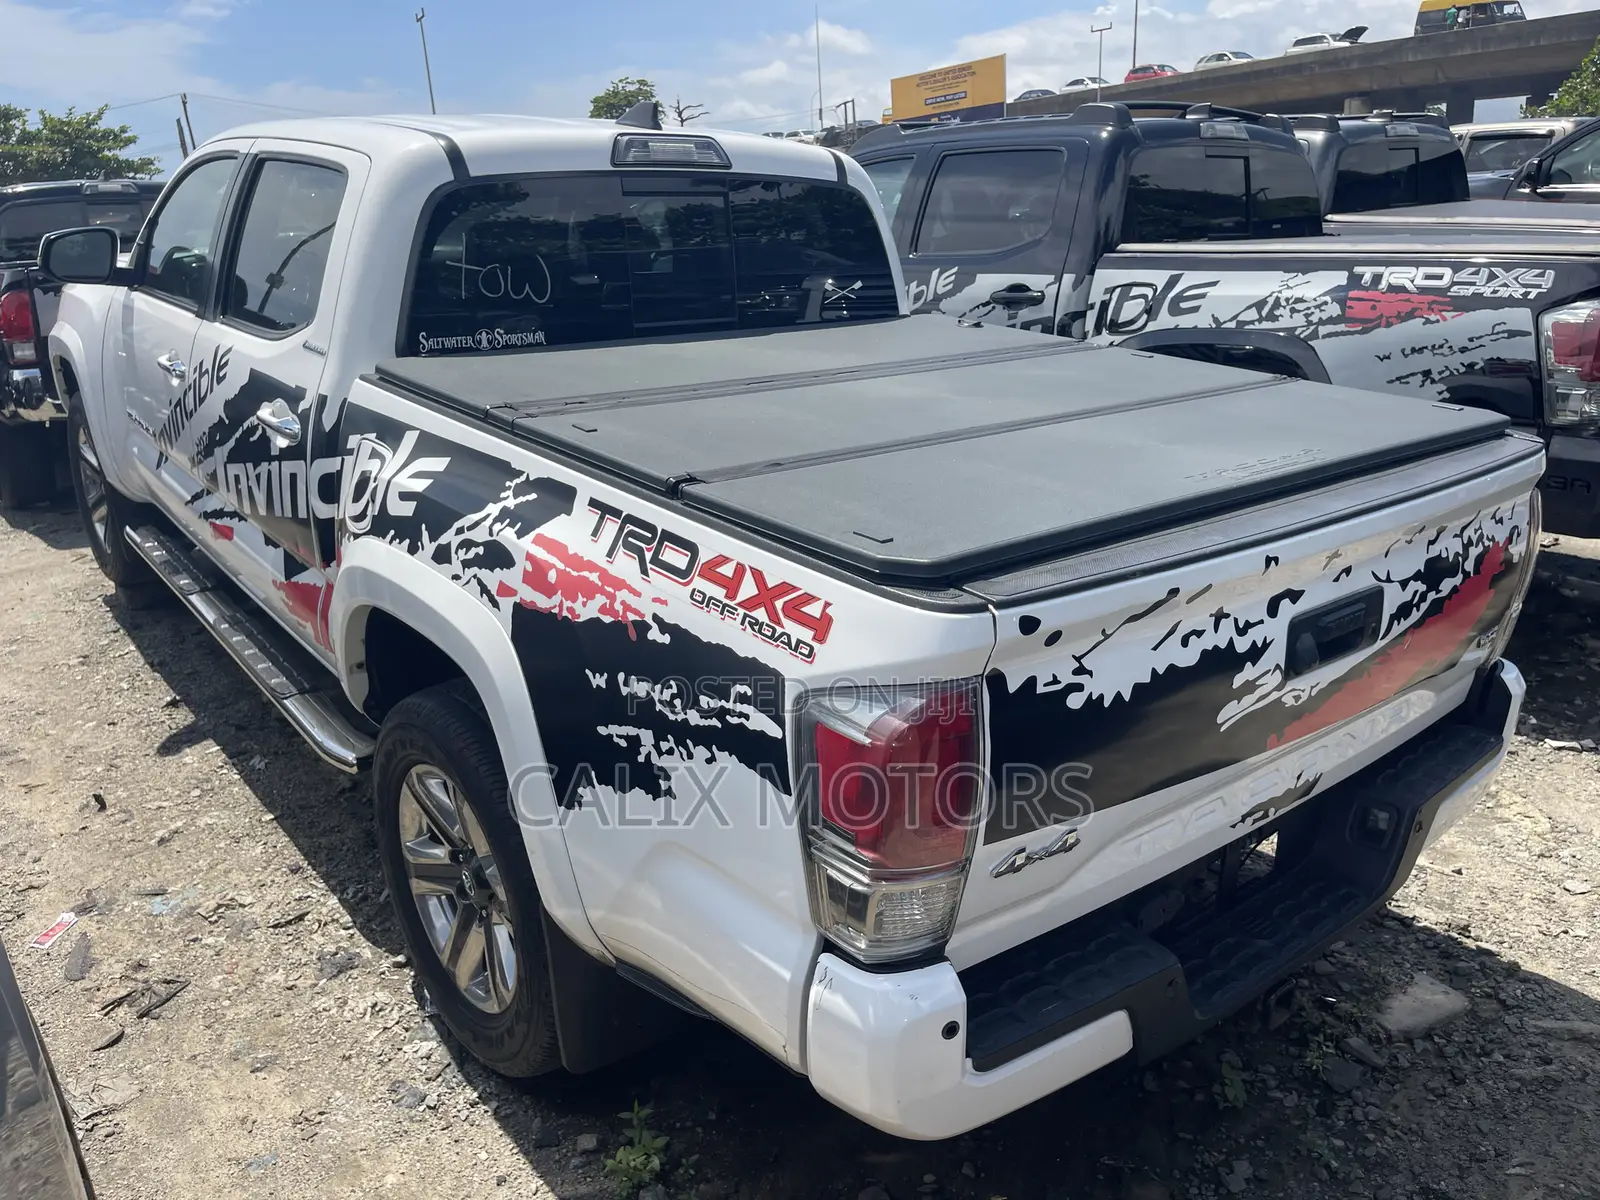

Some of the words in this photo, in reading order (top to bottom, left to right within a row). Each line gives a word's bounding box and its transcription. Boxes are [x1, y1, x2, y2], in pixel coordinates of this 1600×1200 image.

[1353, 266, 1454, 293] TRD
[1447, 285, 1548, 299] SPORT
[587, 496, 701, 588] TRD
[689, 587, 741, 622] OFF
[739, 614, 818, 665] ROAD
